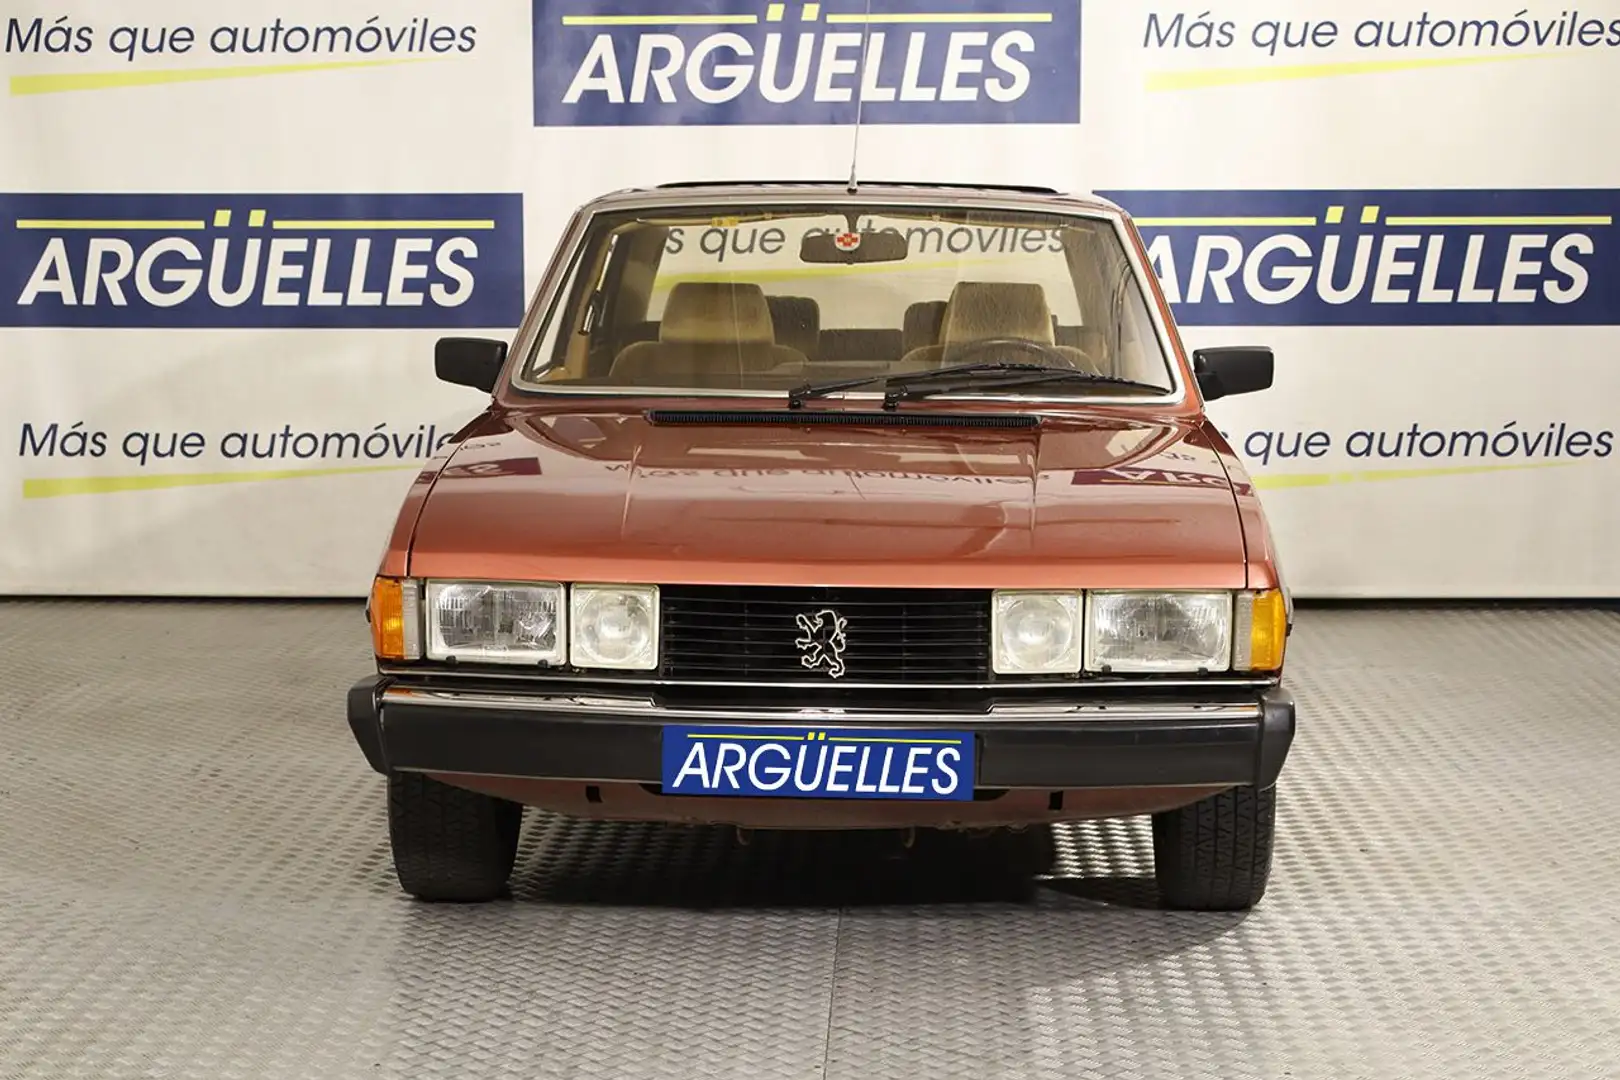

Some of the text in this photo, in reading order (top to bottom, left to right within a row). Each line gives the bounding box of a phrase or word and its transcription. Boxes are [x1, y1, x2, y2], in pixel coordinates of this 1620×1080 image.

[5, 16, 477, 61] Más que automóviles
[561, 3, 1035, 103] ARGÜELLES
[1143, 9, 1620, 56] Más que automóviles
[17, 209, 479, 307] ARGÜELLES
[699, 227, 786, 263] que
[1147, 206, 1595, 304] ARGÜELLES
[18, 421, 455, 465] Más que automóvil
[1244, 430, 1331, 466] que
[1345, 420, 1614, 458] automóviles
[672, 732, 961, 795] ARGÜELLES
